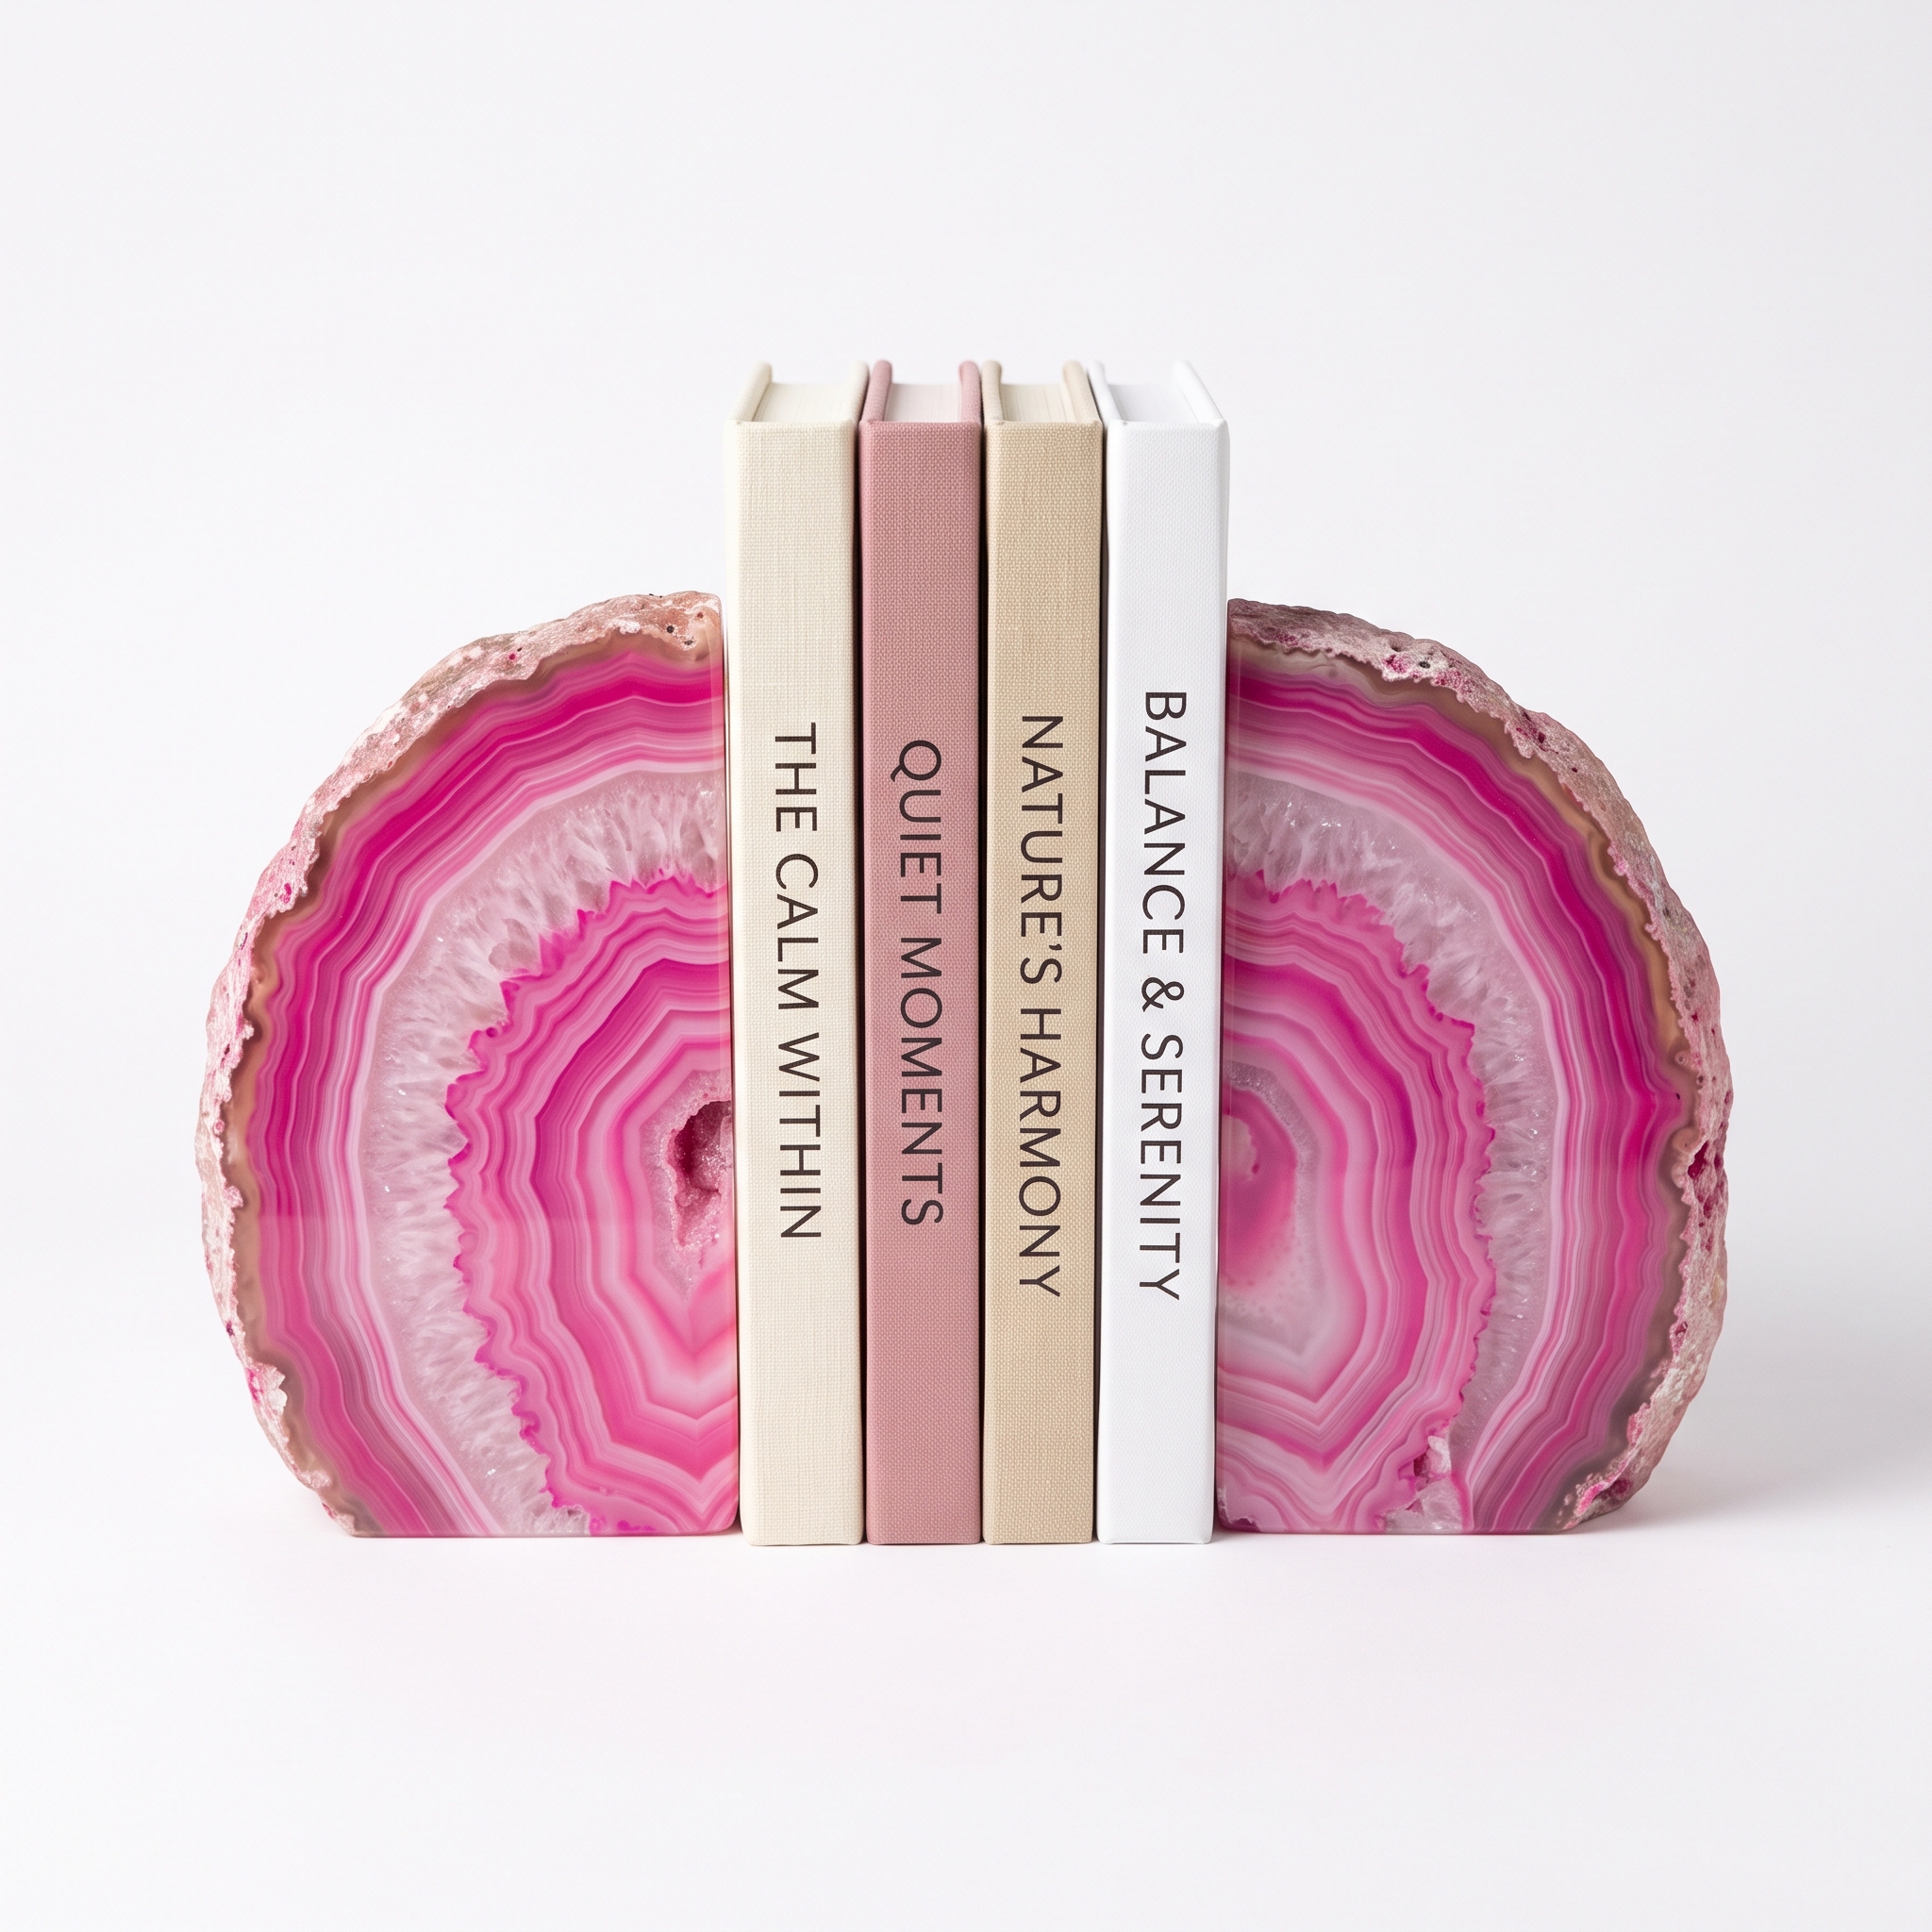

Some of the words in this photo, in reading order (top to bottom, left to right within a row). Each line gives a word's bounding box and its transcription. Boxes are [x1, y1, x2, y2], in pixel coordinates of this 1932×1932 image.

[774, 722, 818, 832] THE
[890, 740, 942, 914] QUIET
[1020, 715, 1064, 985] NATURE’S
[1142, 691, 1187, 955] BALANCE
[775, 853, 819, 1010] CALM
[1141, 976, 1185, 1012] &
[777, 1032, 822, 1238] WITHIN
[900, 937, 944, 1225] MOMENTS
[1018, 1008, 1062, 1297] HARMONY
[1139, 1033, 1184, 1301] SERENITY
